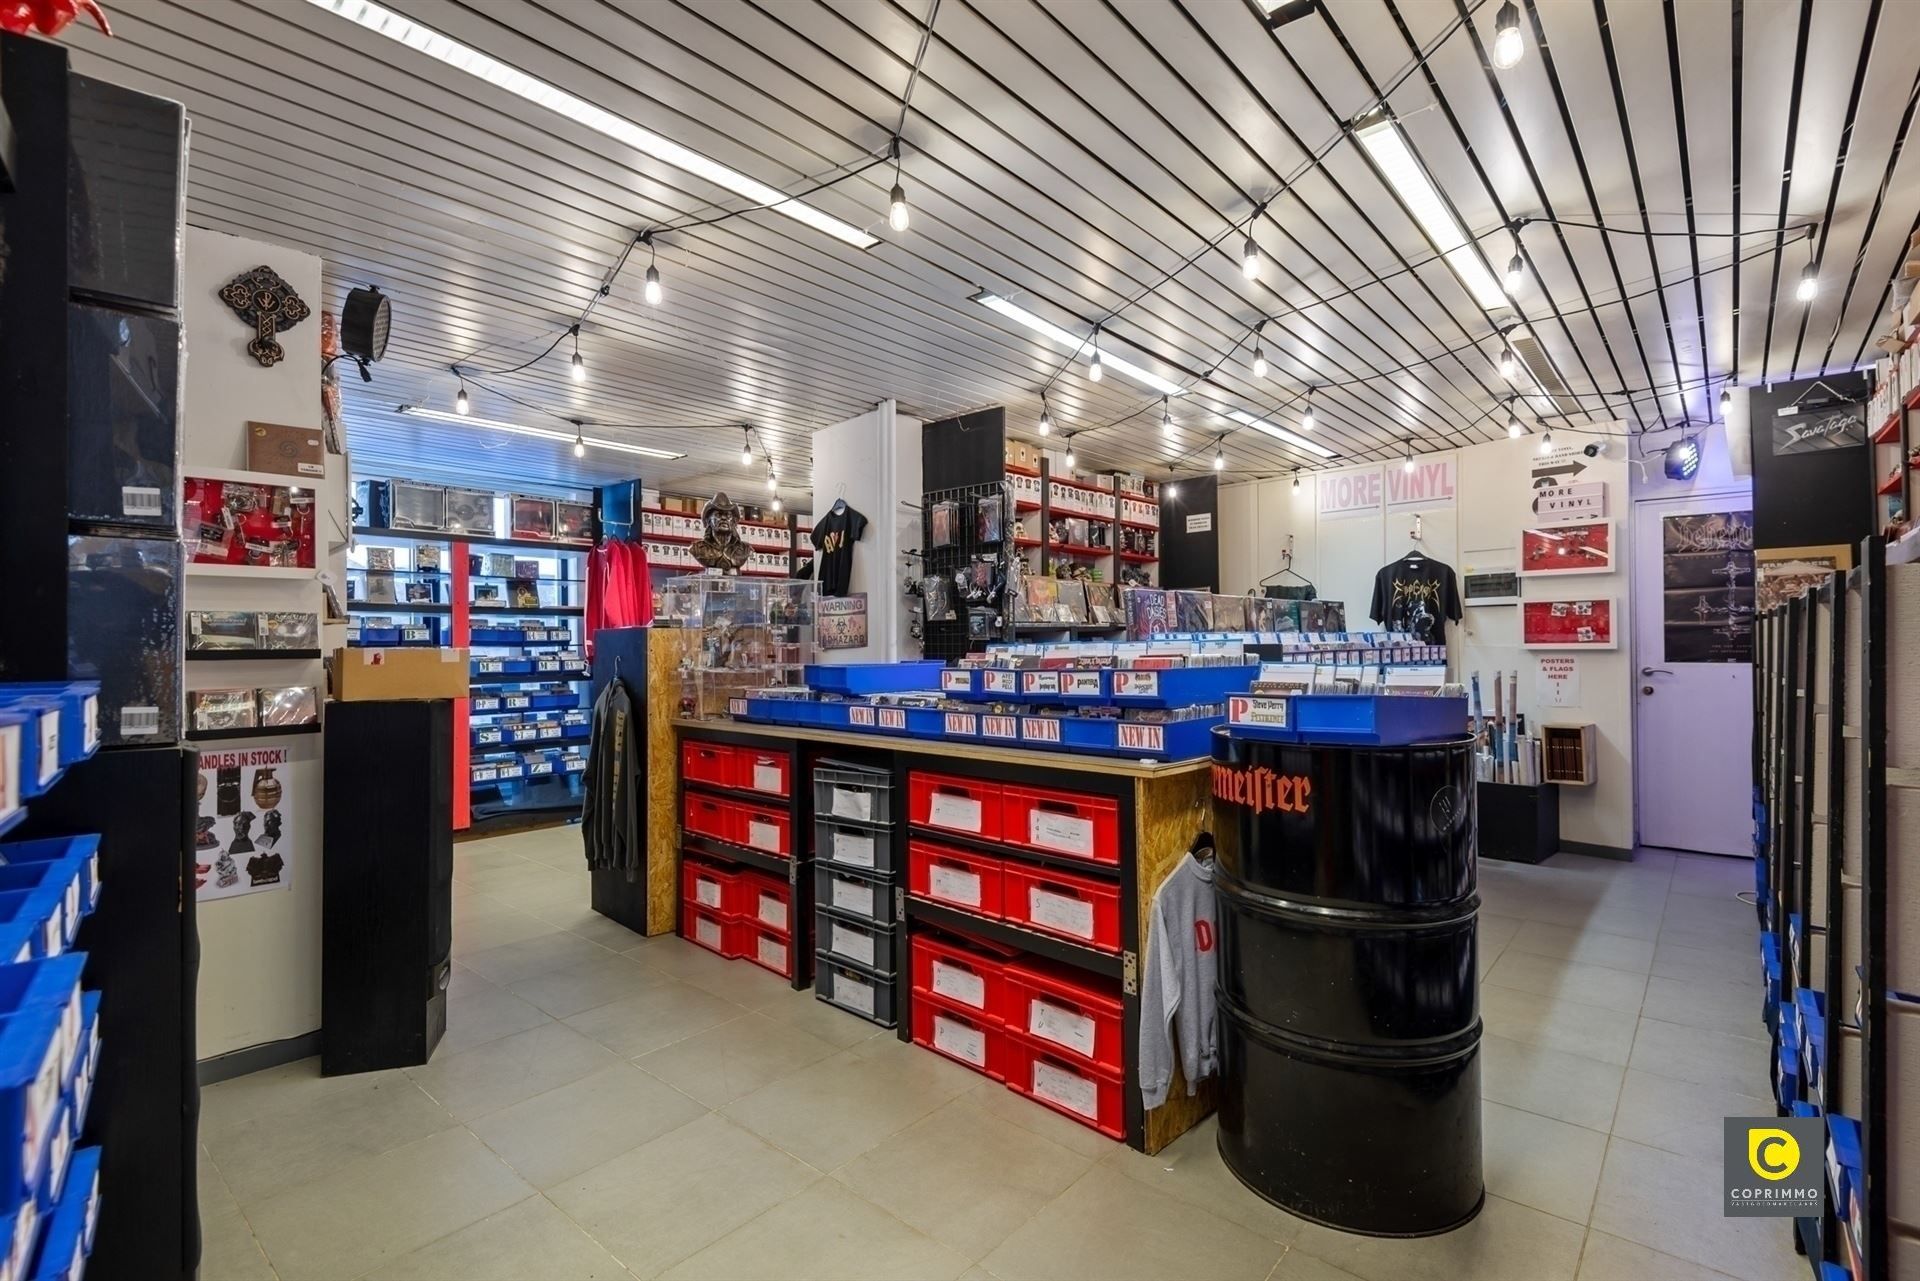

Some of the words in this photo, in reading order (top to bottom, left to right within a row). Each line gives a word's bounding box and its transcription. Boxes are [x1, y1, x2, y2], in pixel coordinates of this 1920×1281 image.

[1320, 473, 1381, 510] MORE
[1387, 462, 1454, 502] VINYL
[1539, 488, 1573, 498] MORE
[1550, 498, 1592, 509] VINYL
[822, 599, 863, 613] WARNING
[943, 672, 953, 689] P
[985, 671, 996, 690] P
[1024, 673, 1035, 692] P
[1061, 674, 1075, 693] P
[1115, 673, 1129, 694] P
[1231, 699, 1248, 722] P
[1253, 699, 1268, 710] Steve
[1268, 701, 1284, 712] Perry
[852, 708, 864, 723] NEW
[865, 709, 874, 725] IN
[881, 710, 895, 726] NEW
[896, 711, 905, 728] IN
[947, 714, 964, 733] NEW
[965, 715, 975, 734] IN
[984, 716, 1003, 736] NEW
[1005, 717, 1015, 737] IN
[1025, 719, 1045, 739] NEW
[1047, 721, 1058, 740] IN
[1121, 726, 1145, 748] NEW
[1148, 727, 1162, 749] IN
[200, 753, 236, 770] ANDLES
[238, 751, 248, 767] IN
[250, 749, 282, 766] STOCK
[1195, 919, 1213, 952] D
